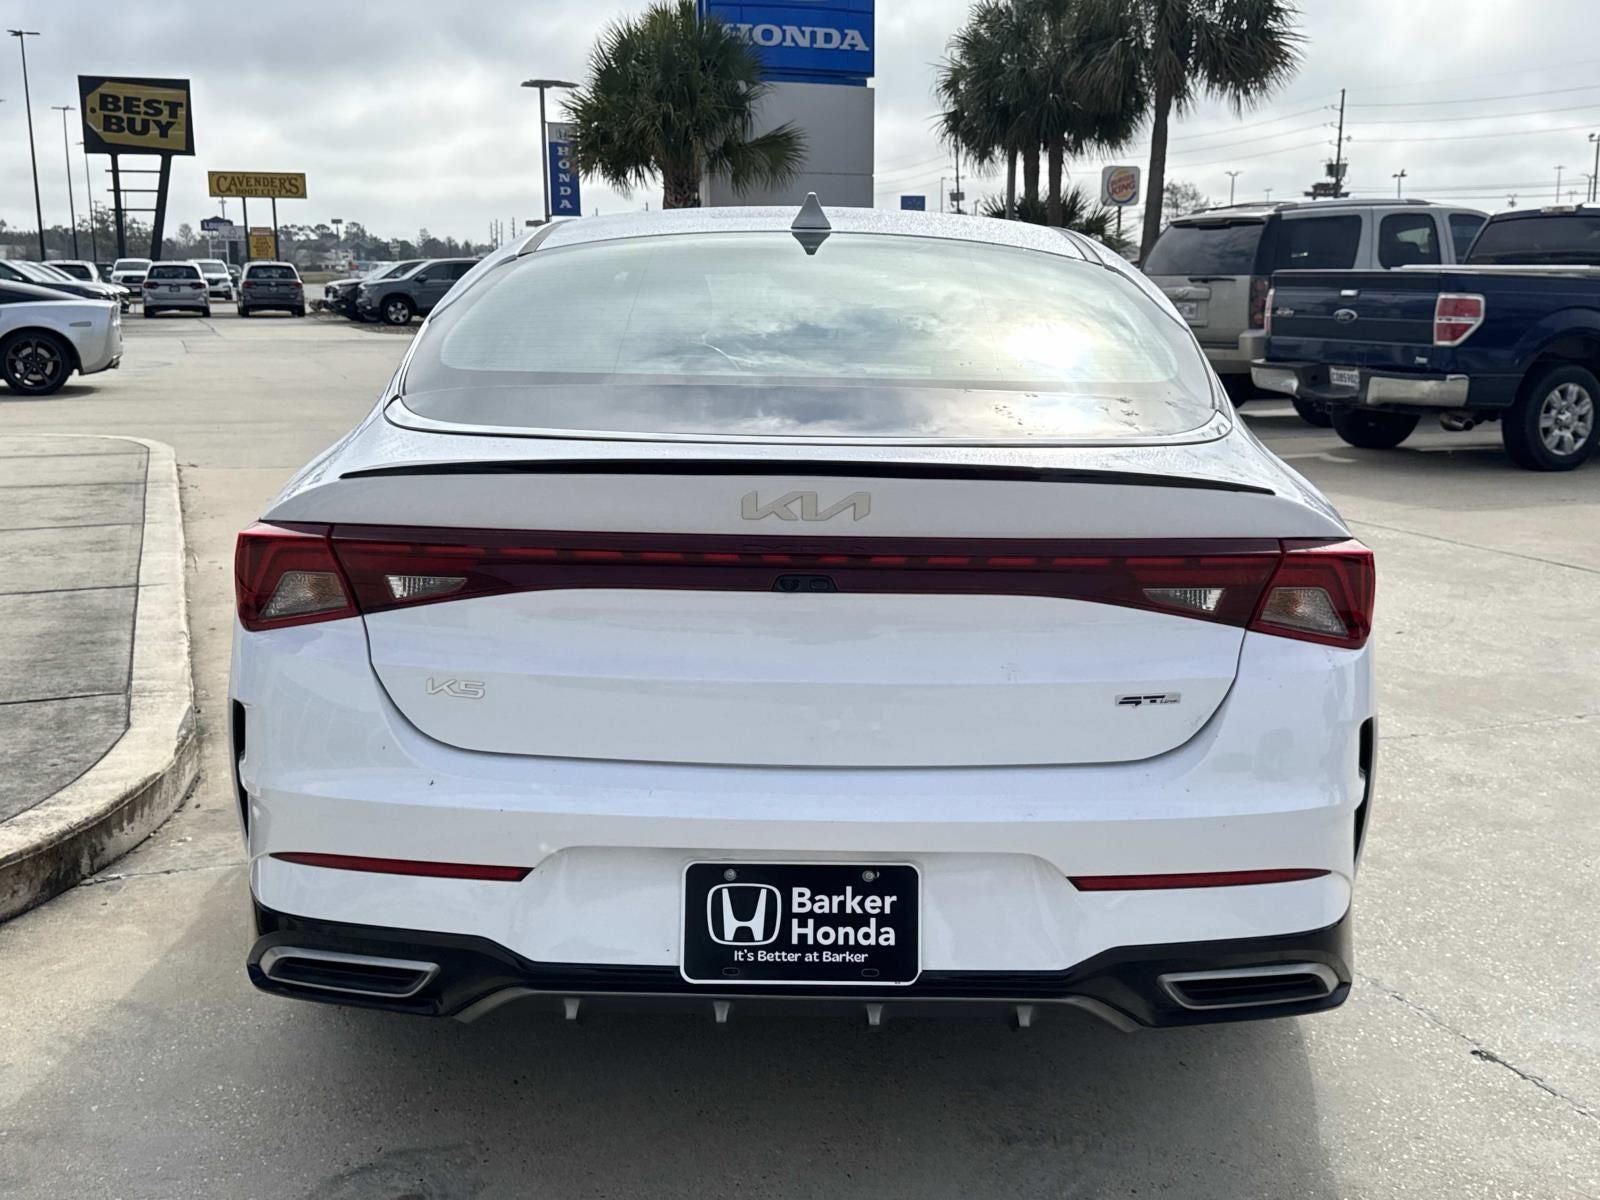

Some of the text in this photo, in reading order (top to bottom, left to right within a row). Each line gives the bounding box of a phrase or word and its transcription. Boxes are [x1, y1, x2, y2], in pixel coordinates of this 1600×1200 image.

[99, 93, 183, 119] BEST
[102, 114, 177, 138] BUY
[216, 175, 300, 195] CAVENDER'S
[557, 146, 572, 209] HONDA
[1111, 179, 1136, 194] KING
[741, 490, 871, 522] KIA
[426, 677, 485, 699] K5
[791, 886, 897, 914] Barker
[791, 918, 896, 946] Honda
[734, 950, 868, 963] It's Better at Barker
